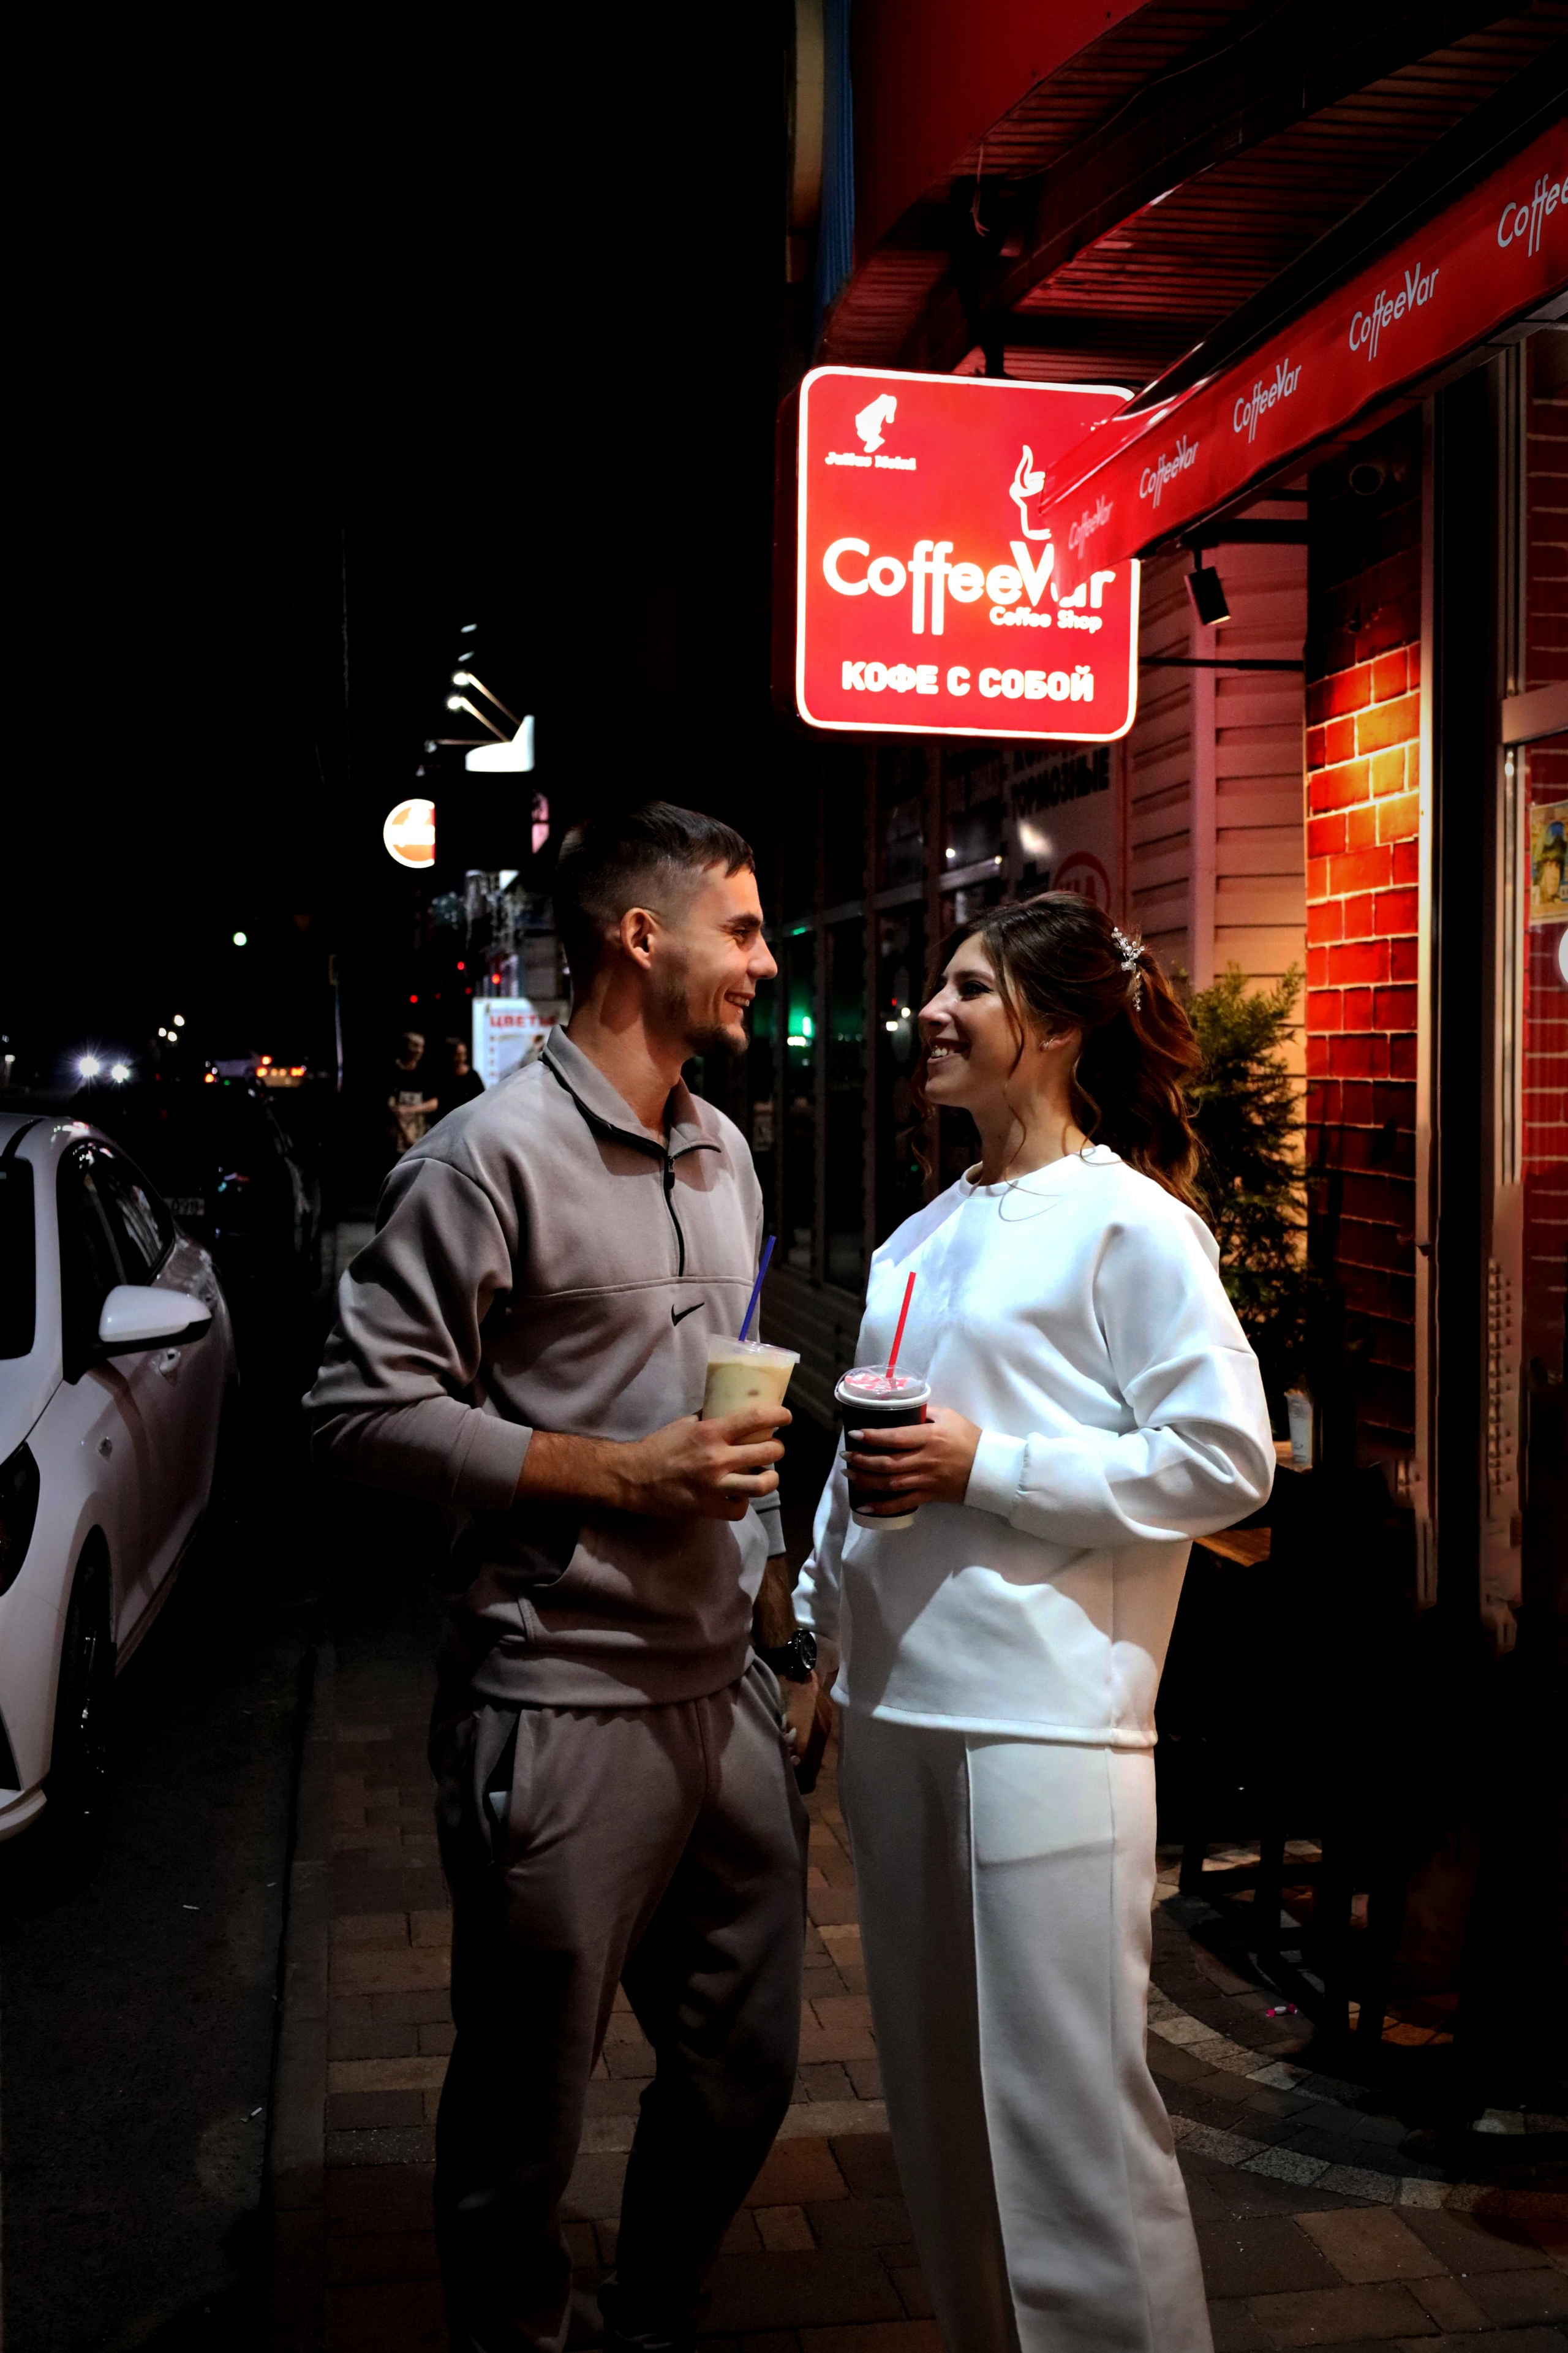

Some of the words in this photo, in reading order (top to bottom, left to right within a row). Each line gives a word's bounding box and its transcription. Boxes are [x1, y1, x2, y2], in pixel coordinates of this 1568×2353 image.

[1349, 262, 1439, 361] CoffeeVar
[1233, 358, 1302, 444] CoffeeVar
[1139, 434, 1199, 509] CoffeeVar
[989, 606, 1052, 628] Coffee
[1057, 610, 1102, 634] Shop
[842, 661, 939, 695] КОФЕ
[947, 666, 971, 697] С
[979, 665, 1094, 702] СОБОЙ
